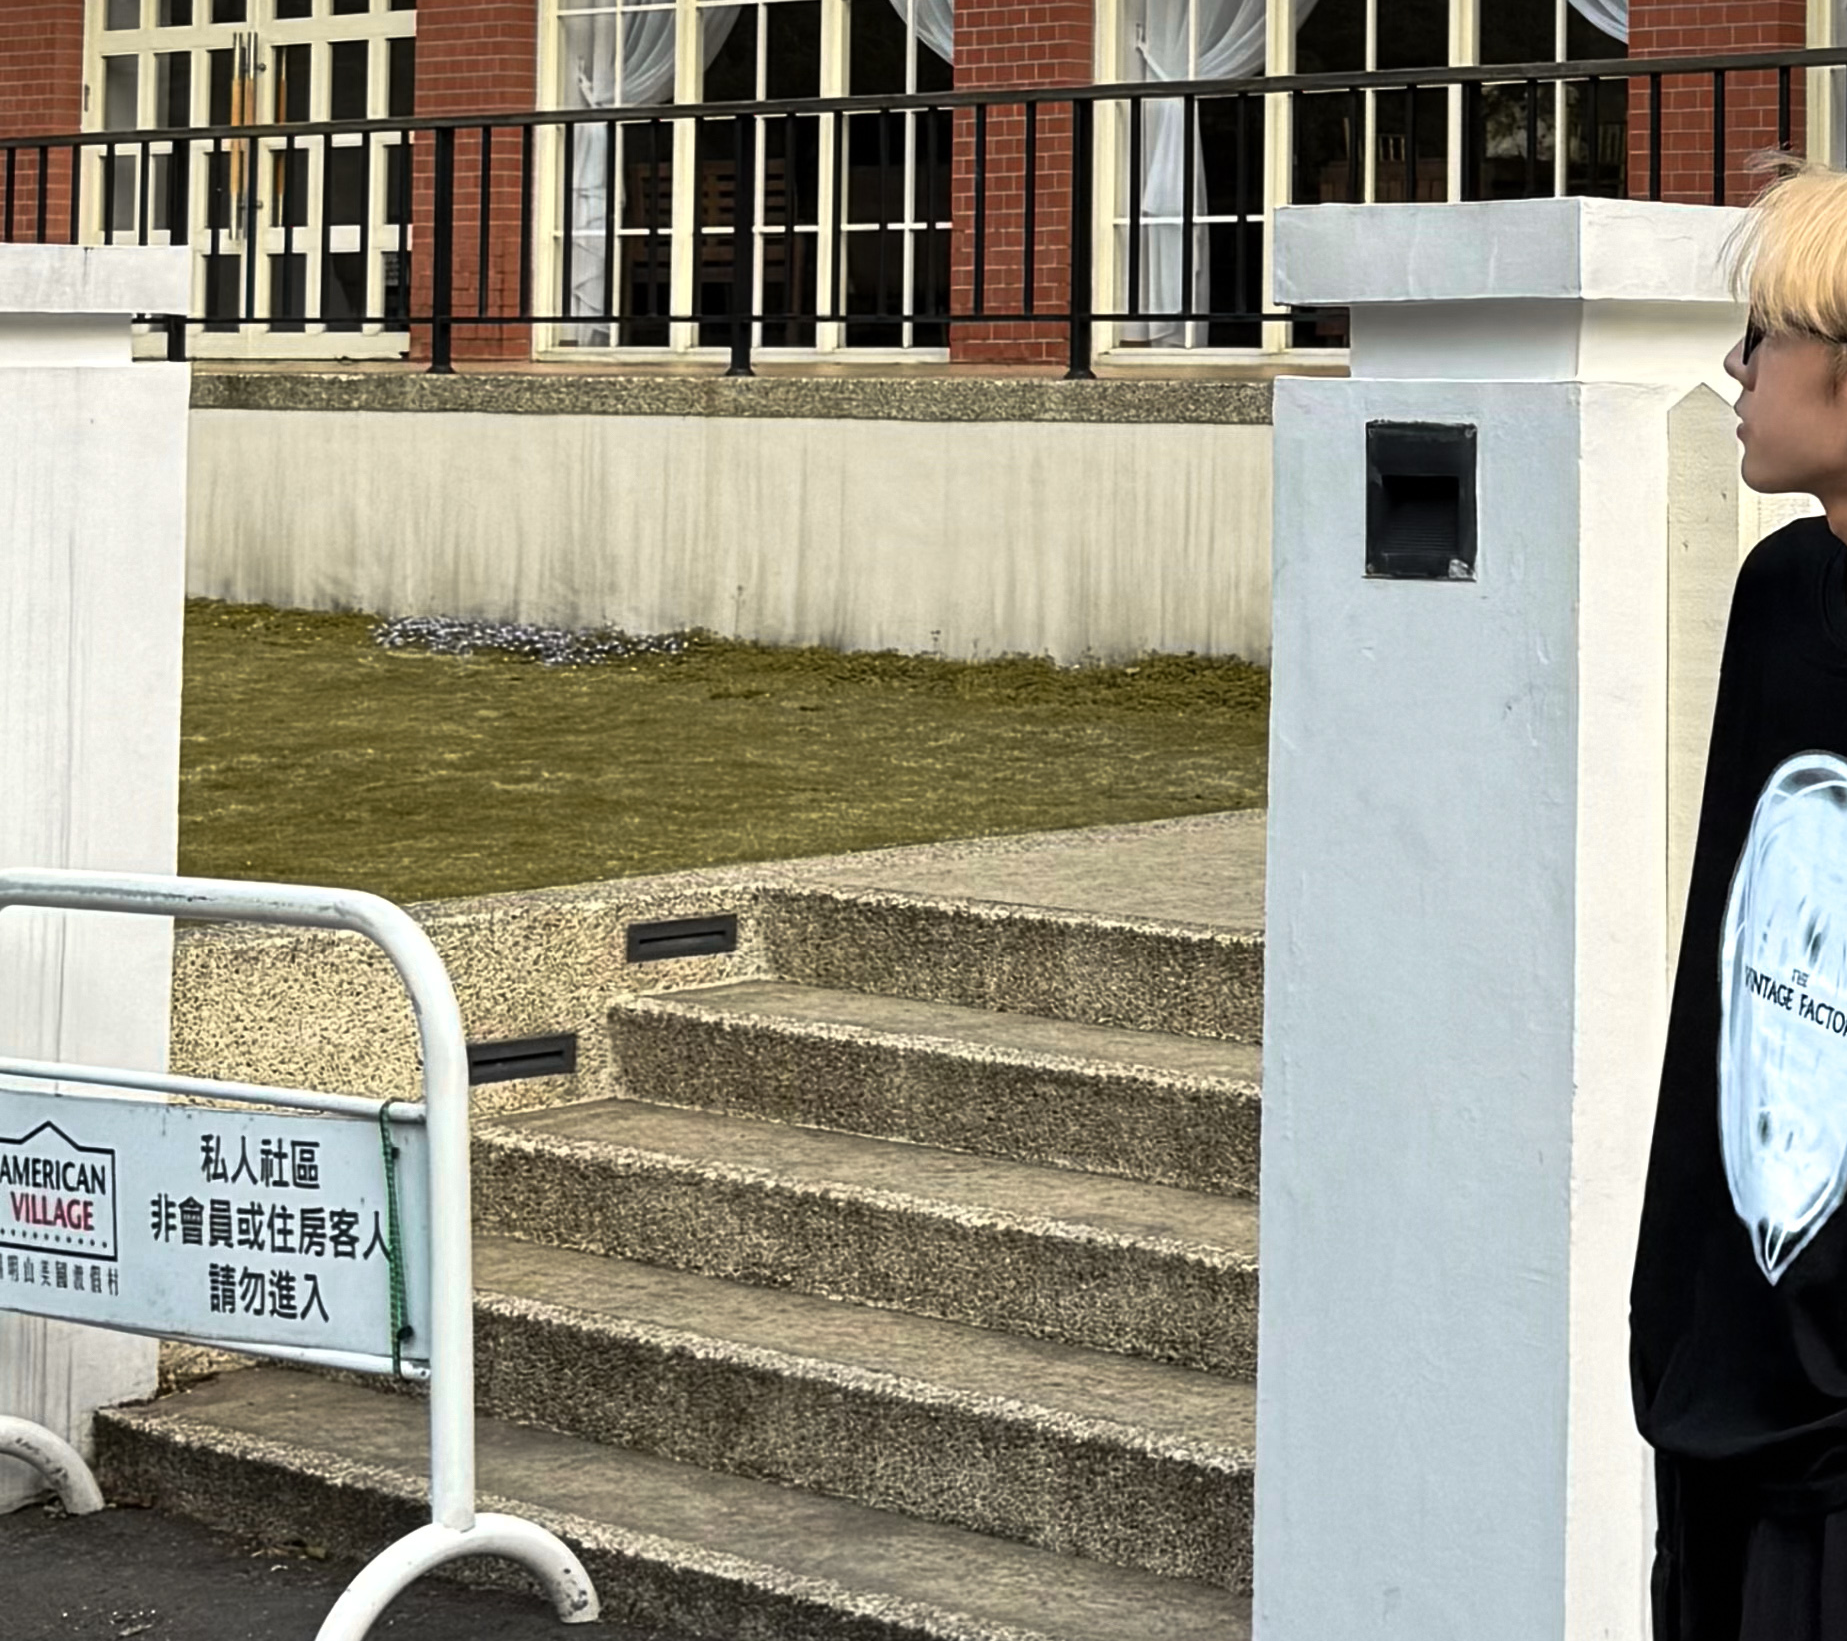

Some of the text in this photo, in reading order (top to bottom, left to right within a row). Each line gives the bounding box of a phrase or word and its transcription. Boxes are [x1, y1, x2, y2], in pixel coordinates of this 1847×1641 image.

[0, 1154, 106, 1195] AMERICAN
[200, 1134, 321, 1189] 私人社區
[10, 1191, 95, 1231] VILLAGE
[150, 1193, 391, 1260] 非會員或住房客人
[0, 1252, 119, 1297] 明山美國渡假村
[208, 1263, 330, 1323] 請勿進入
